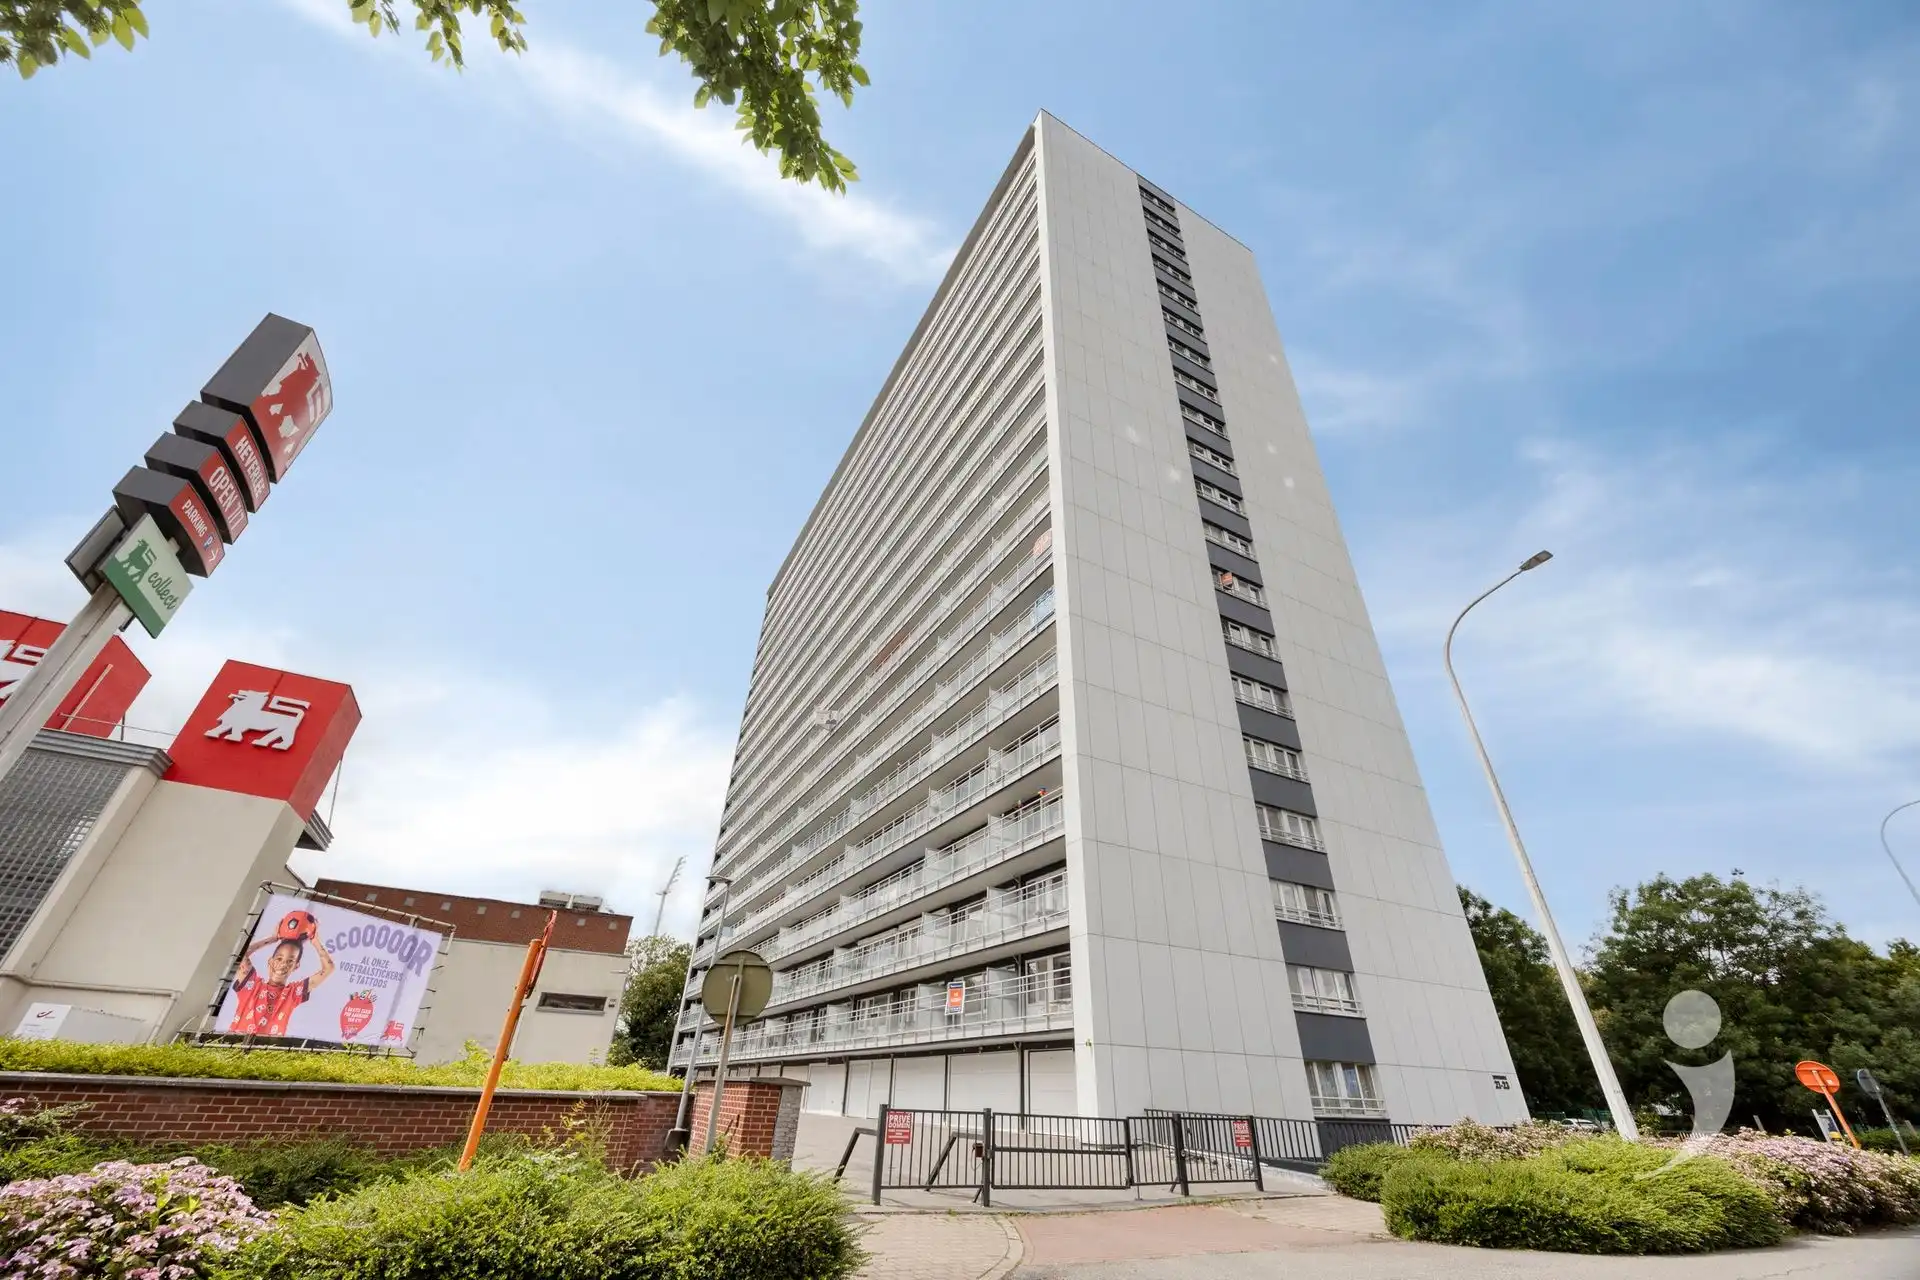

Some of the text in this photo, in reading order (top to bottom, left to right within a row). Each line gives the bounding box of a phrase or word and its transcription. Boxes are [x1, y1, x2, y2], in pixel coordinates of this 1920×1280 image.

[235, 435, 265, 499] HEVERLEE
[208, 465, 238, 513] OPEN
[181, 499, 208, 537] PARKING
[147, 571, 179, 610] collect
[339, 960, 404, 982] VOETBALSTICKERS
[360, 956, 390, 969] AL ONZE
[356, 975, 388, 989] TATTOOS
